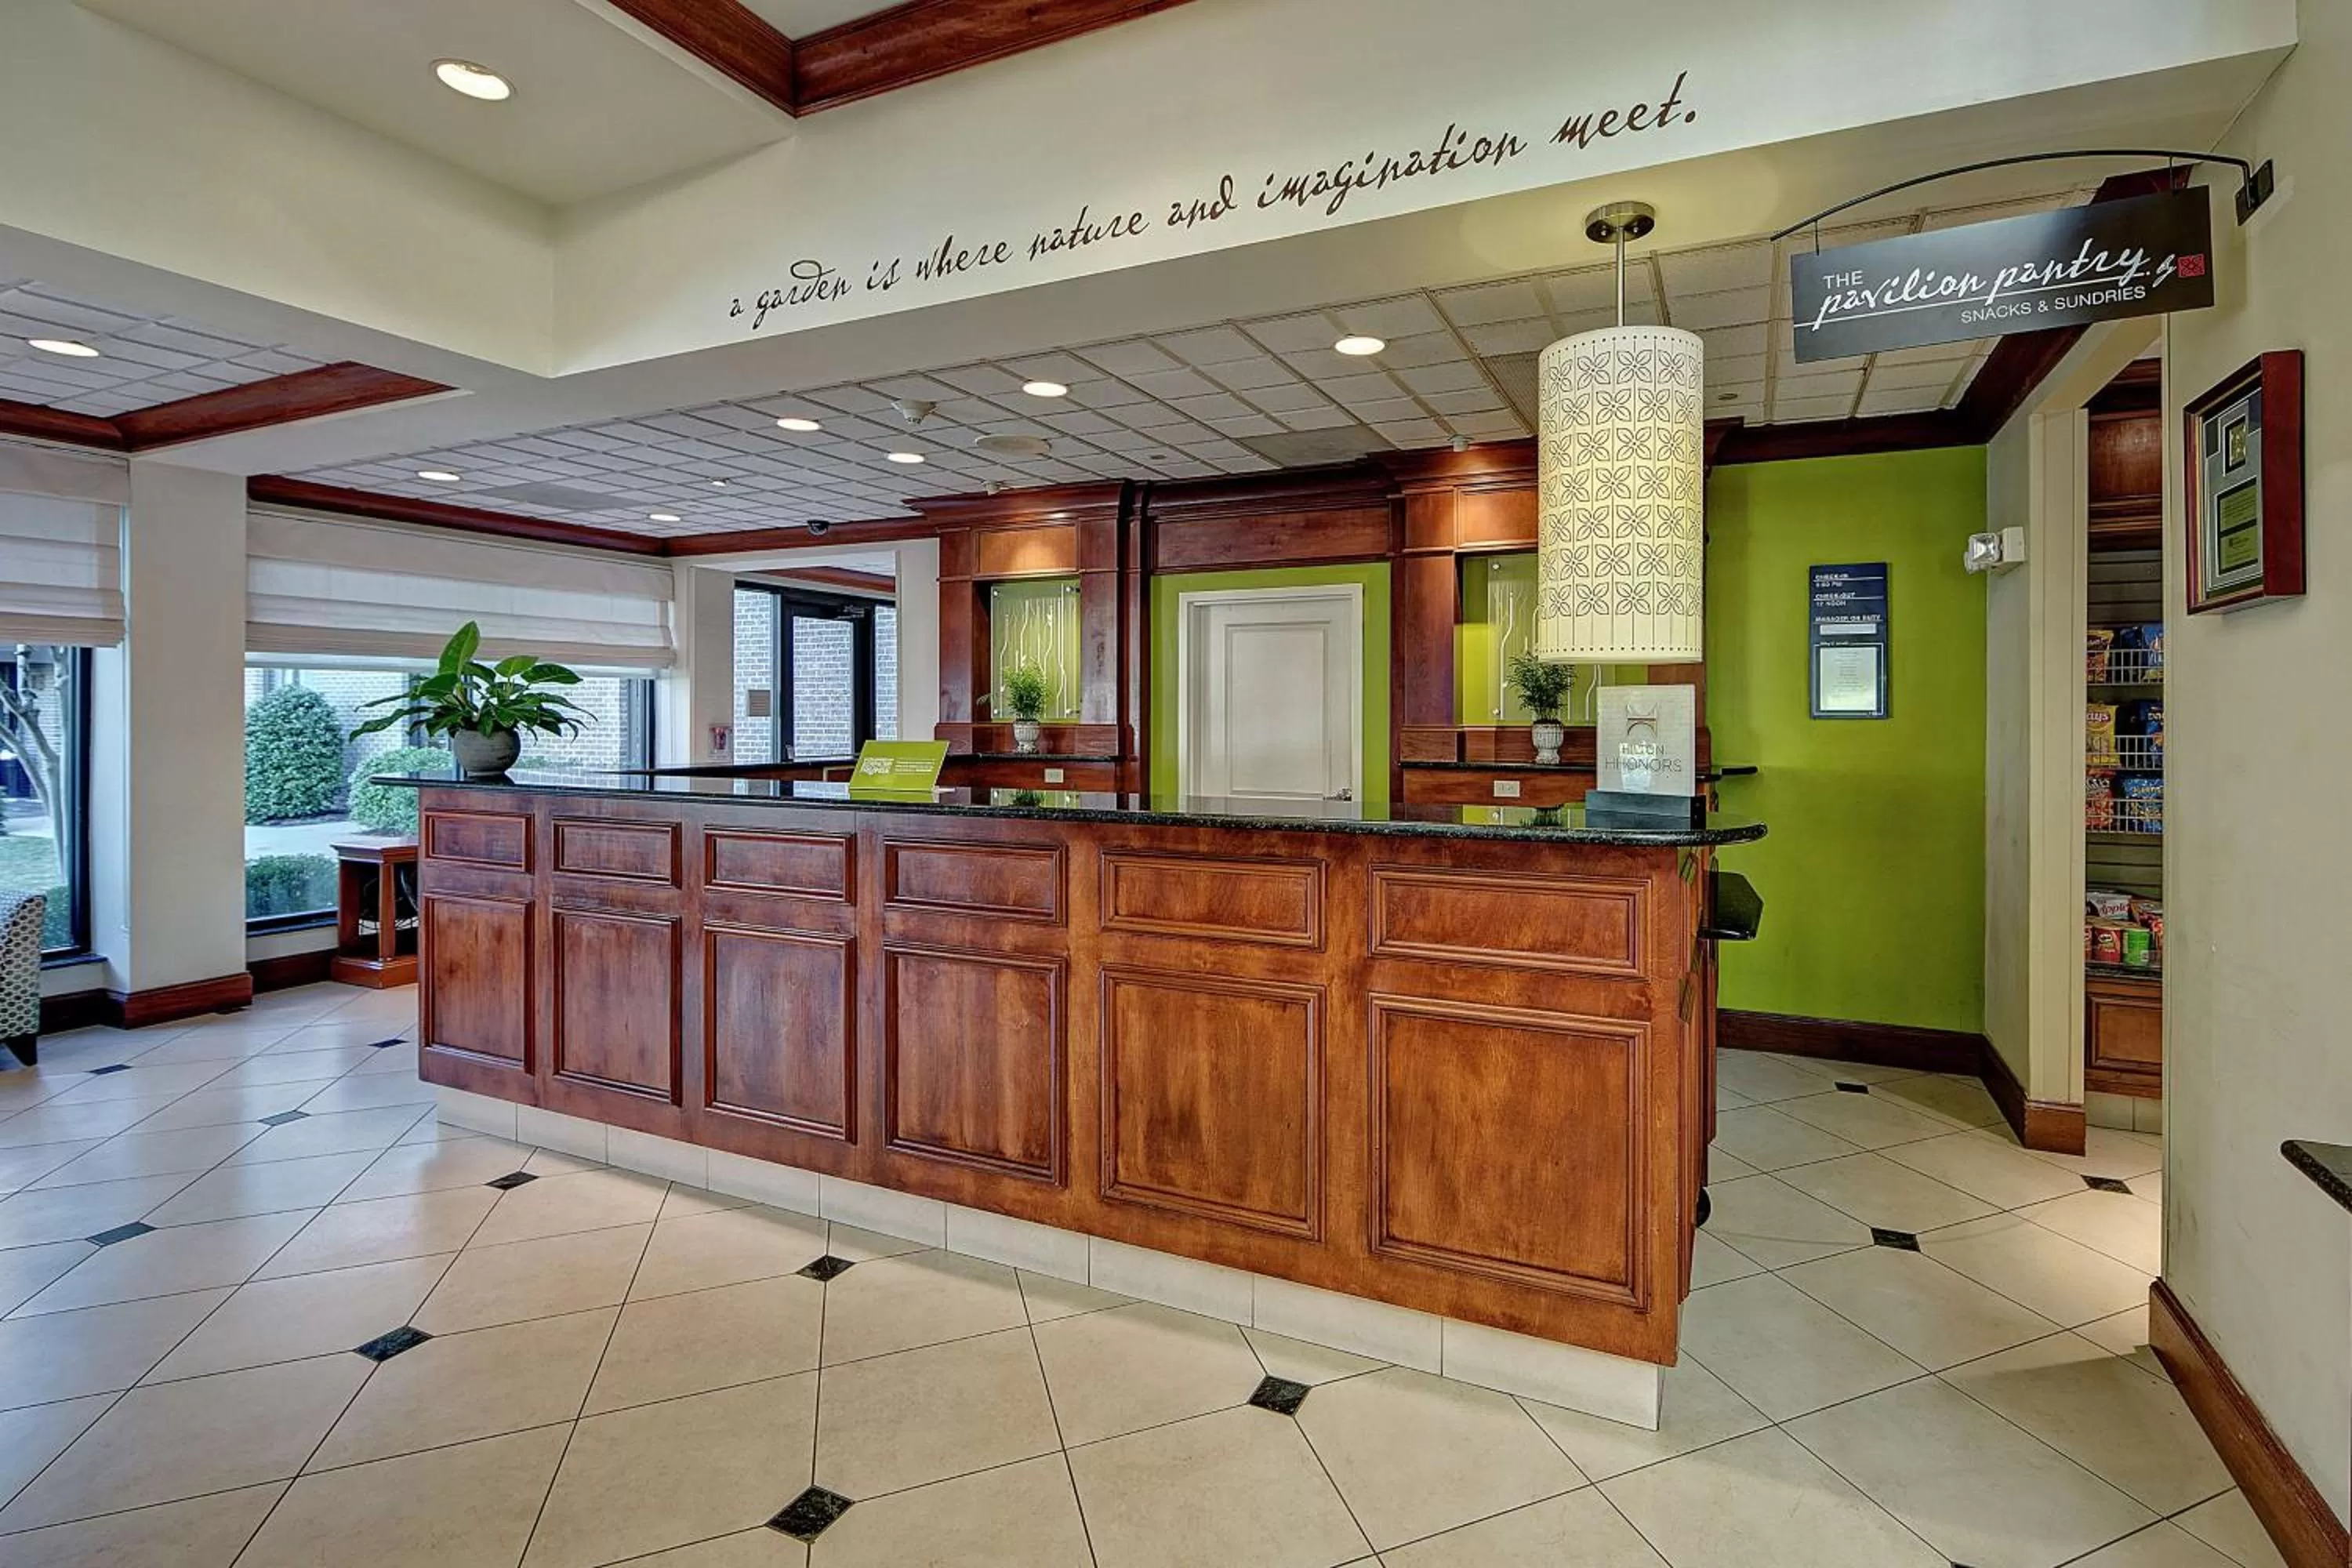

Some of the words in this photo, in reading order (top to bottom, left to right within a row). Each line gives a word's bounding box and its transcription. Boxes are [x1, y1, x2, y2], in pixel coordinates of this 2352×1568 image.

[730, 298, 744, 318] a
[752, 260, 853, 329] garden
[866, 259, 902, 291] is
[916, 234, 1012, 281] where
[1029, 205, 1149, 263] nature
[1168, 176, 1237, 228] and
[1257, 124, 1528, 216] imagination
[1550, 71, 1697, 149] meet.
[1812, 267, 1987, 332] pavilion
[1823, 270, 1864, 289] THE
[1961, 301, 2032, 324] SNACKS
[2038, 300, 2049, 314] &
[2054, 285, 2146, 310] SUNDRIES
